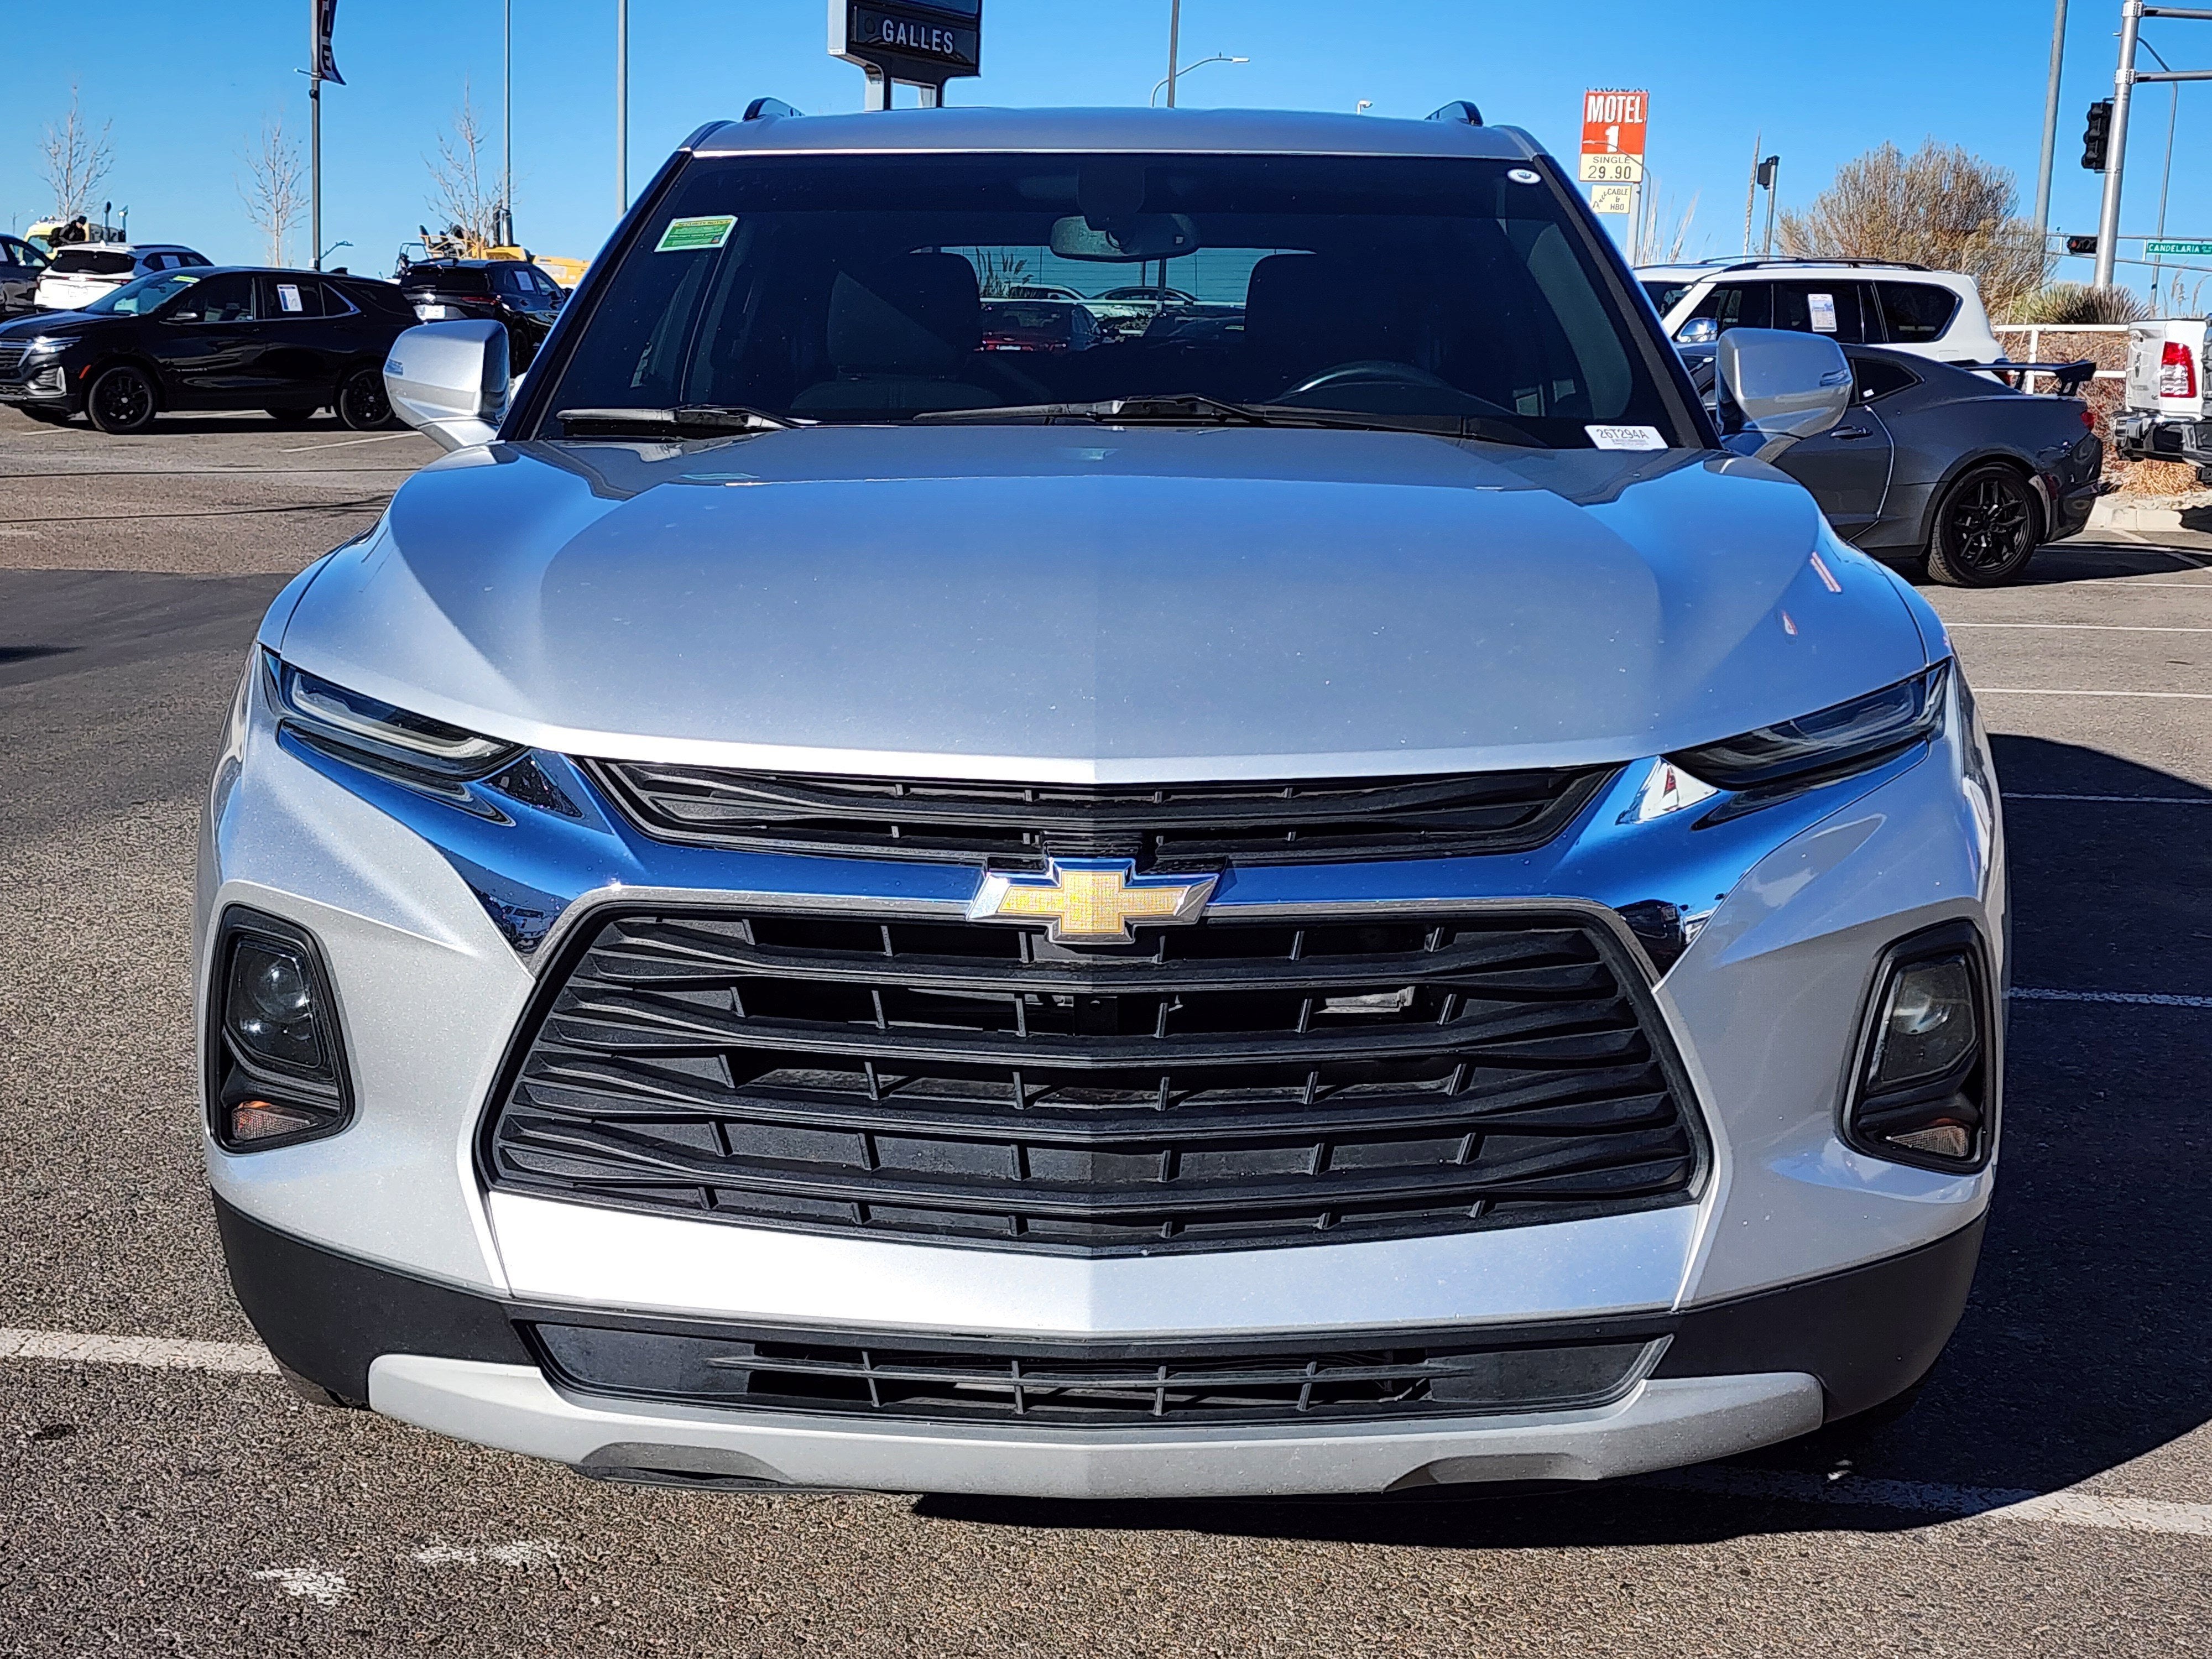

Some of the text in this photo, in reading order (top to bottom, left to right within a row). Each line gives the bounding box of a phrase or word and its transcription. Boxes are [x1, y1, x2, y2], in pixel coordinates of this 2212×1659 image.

[883, 19, 953, 54] GALLES
[1587, 95, 1643, 123] MOTEL
[1605, 126, 1620, 153] 1
[1588, 165, 1631, 179] 29.90
[2148, 244, 2200, 253] CANDELARIA
[1597, 429, 1650, 439] 26T294A
